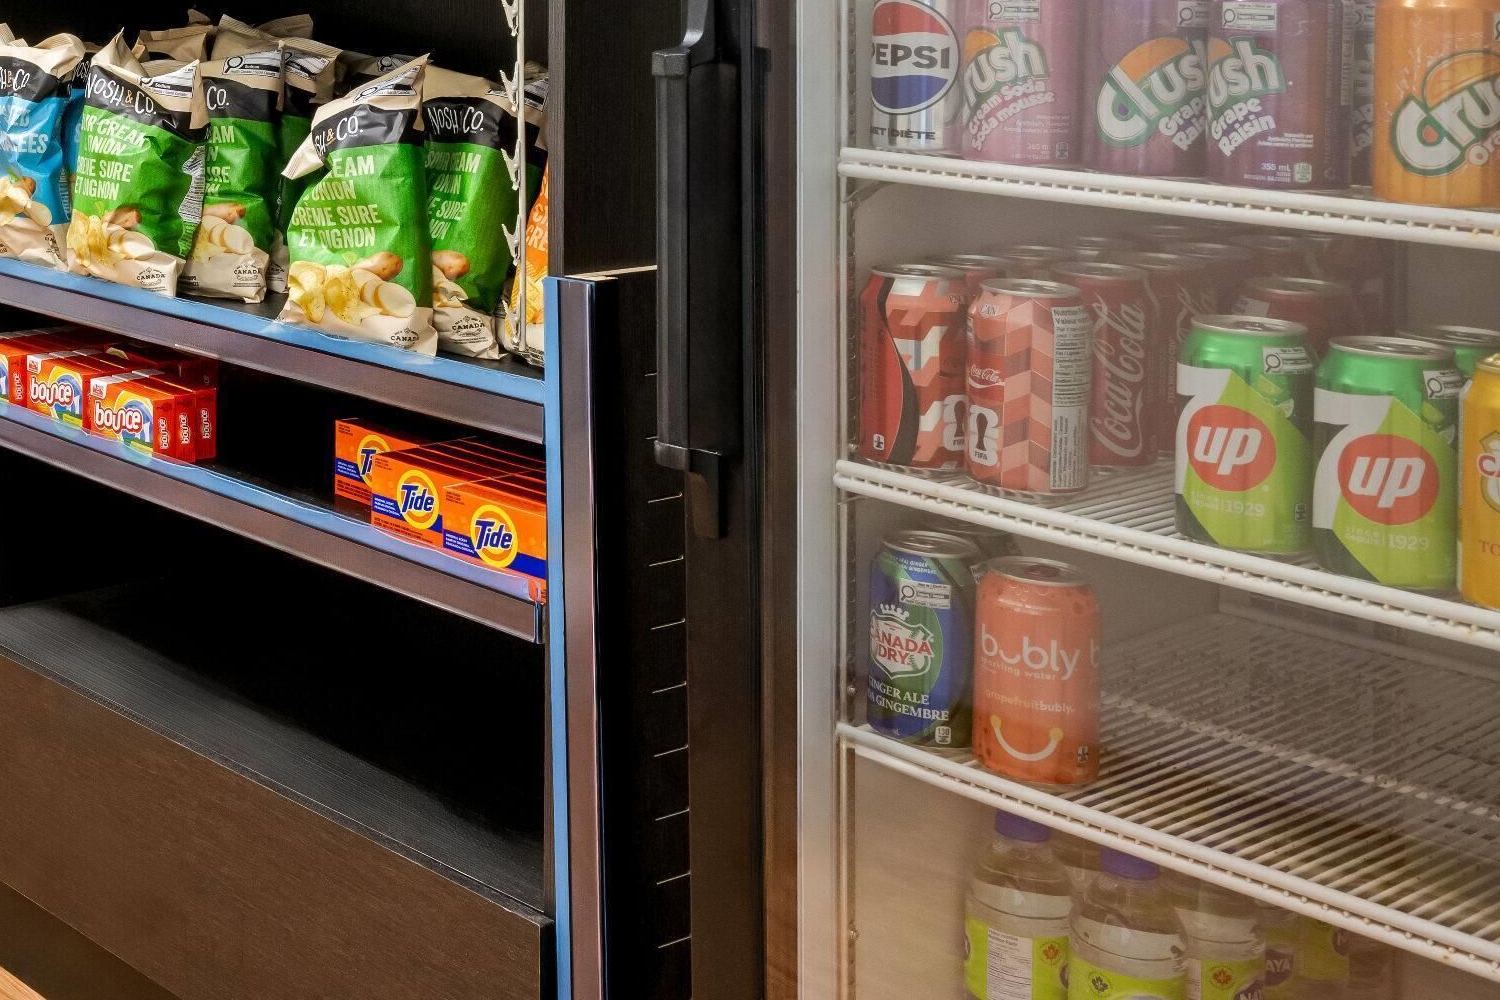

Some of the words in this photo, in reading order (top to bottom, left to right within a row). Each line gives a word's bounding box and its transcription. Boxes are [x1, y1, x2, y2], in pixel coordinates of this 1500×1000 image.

[963, 30, 1047, 109] rush
[85, 72, 124, 106] NOSH
[125, 89, 134, 106] &
[135, 90, 157, 115] CO.
[206, 85, 229, 110] CO.
[968, 94, 1003, 135] Cream
[1001, 79, 1046, 101] Soda
[336, 115, 364, 142] CO.
[427, 106, 459, 136] NOSH
[463, 105, 484, 135] CO.
[1159, 97, 1203, 137] Grap
[1211, 97, 1262, 141] Grape
[971, 117, 999, 152] Soda
[1218, 114, 1277, 157] Raisin
[99, 159, 134, 183] SURE
[332, 155, 375, 179] EAM
[292, 198, 335, 228] CRÈME
[338, 203, 383, 227] SURE
[301, 226, 316, 246] ET
[322, 227, 377, 250] OIGNON
[451, 322, 486, 333] CANADA
[30, 379, 74, 407] bounce
[94, 402, 143, 434] bounce
[159, 416, 168, 450] bounce
[180, 413, 189, 446] bounce
[201, 407, 209, 440] bounce
[360, 448, 376, 476] Ti
[974, 450, 988, 461] FIFA
[400, 484, 435, 514] Tide
[1225, 501, 1265, 517] 1929
[474, 519, 513, 551] Tide
[1388, 534, 1429, 550] 1929
[877, 644, 909, 665] DRY
[981, 623, 1080, 680] bubly
[876, 694, 949, 721] GINGEMBRE
[903, 691, 930, 706] ALE
[1266, 958, 1292, 972] AYA
